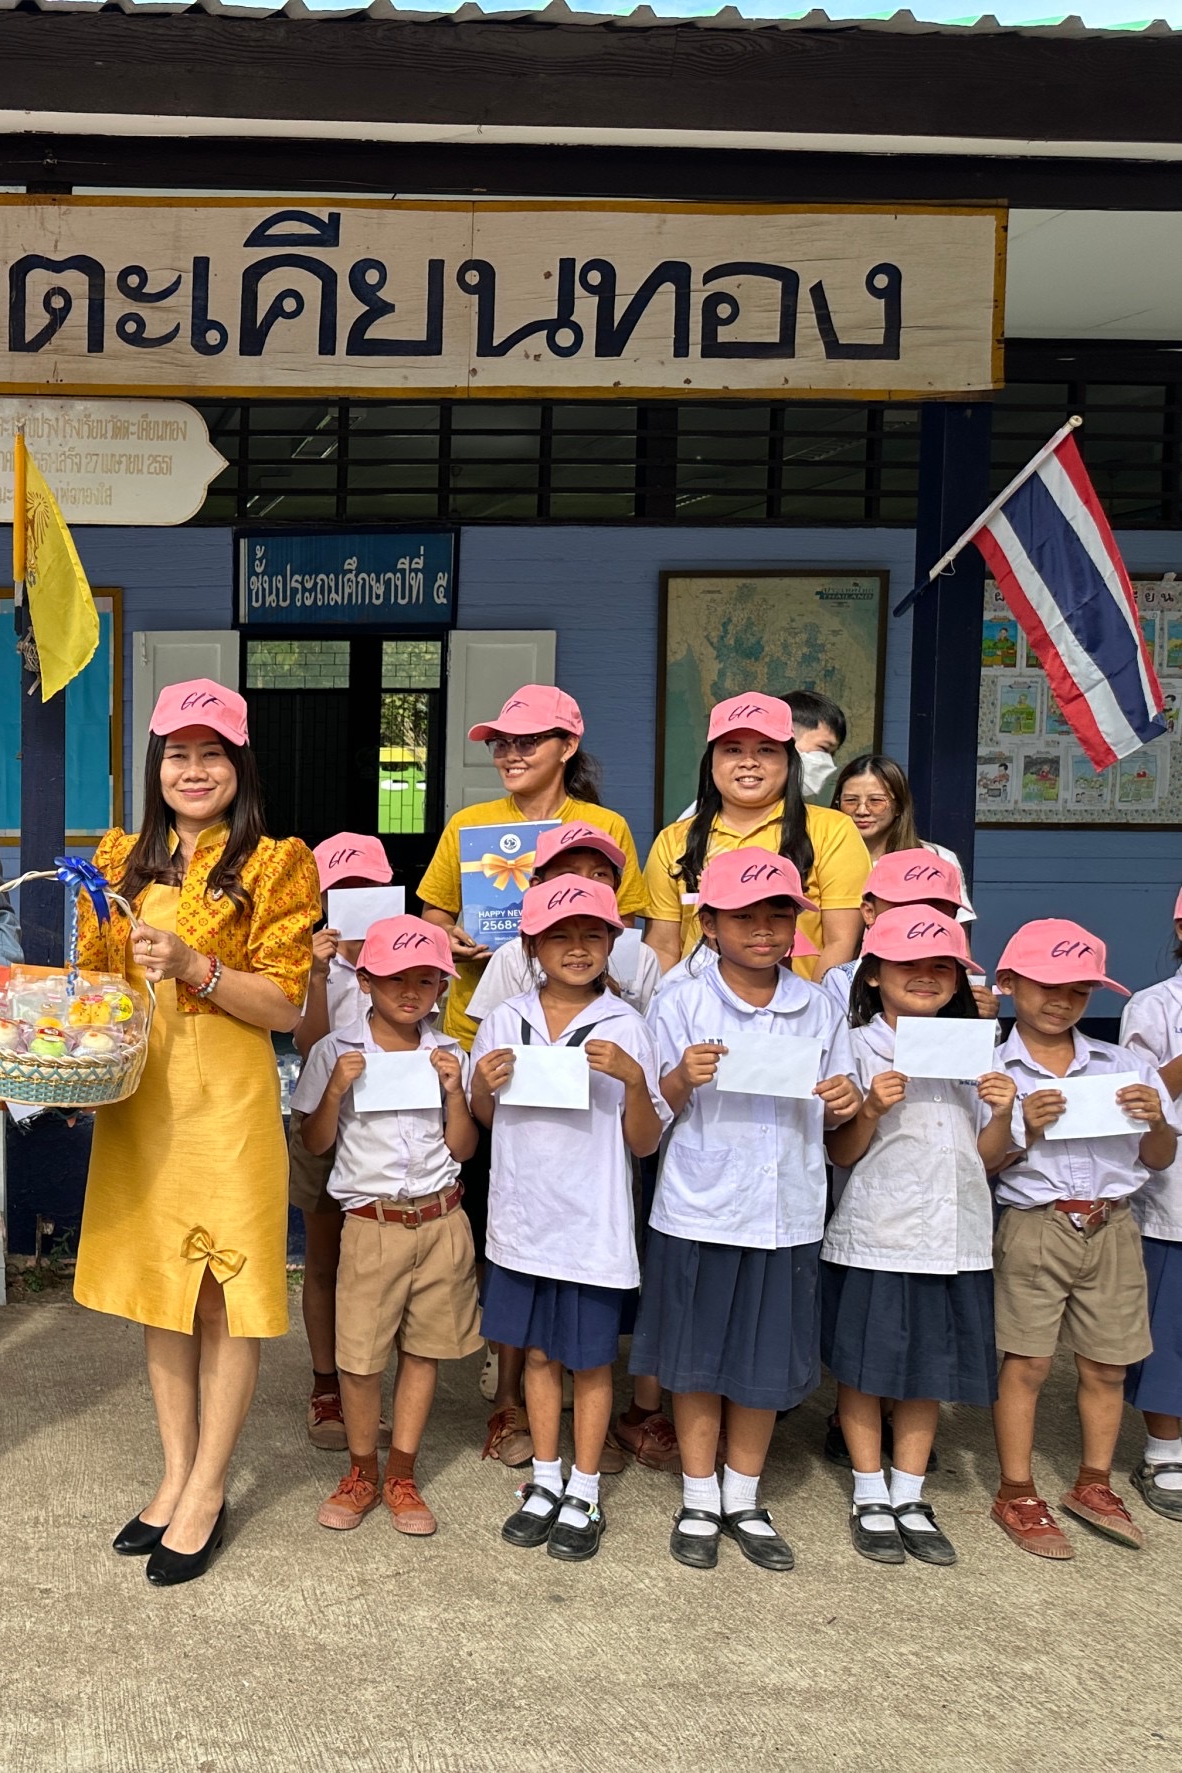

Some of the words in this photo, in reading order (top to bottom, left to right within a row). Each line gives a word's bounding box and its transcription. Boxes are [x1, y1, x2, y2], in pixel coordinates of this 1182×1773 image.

[84, 453, 99, 474] 27
[146, 454, 173, 476] 2551
[250, 545, 424, 608] ชั้นประถมศึกษาปีที่
[433, 571, 448, 605] ๕
[180, 692, 226, 711] GIF
[728, 705, 770, 721] GIF
[329, 848, 365, 869] GIF
[740, 864, 786, 884] GIF
[904, 865, 946, 881] GIF
[548, 888, 594, 910] GIF
[478, 910, 506, 918] HAPPY
[906, 921, 952, 940] GIF
[393, 932, 435, 951] GIF
[1051, 940, 1096, 958] GIF
